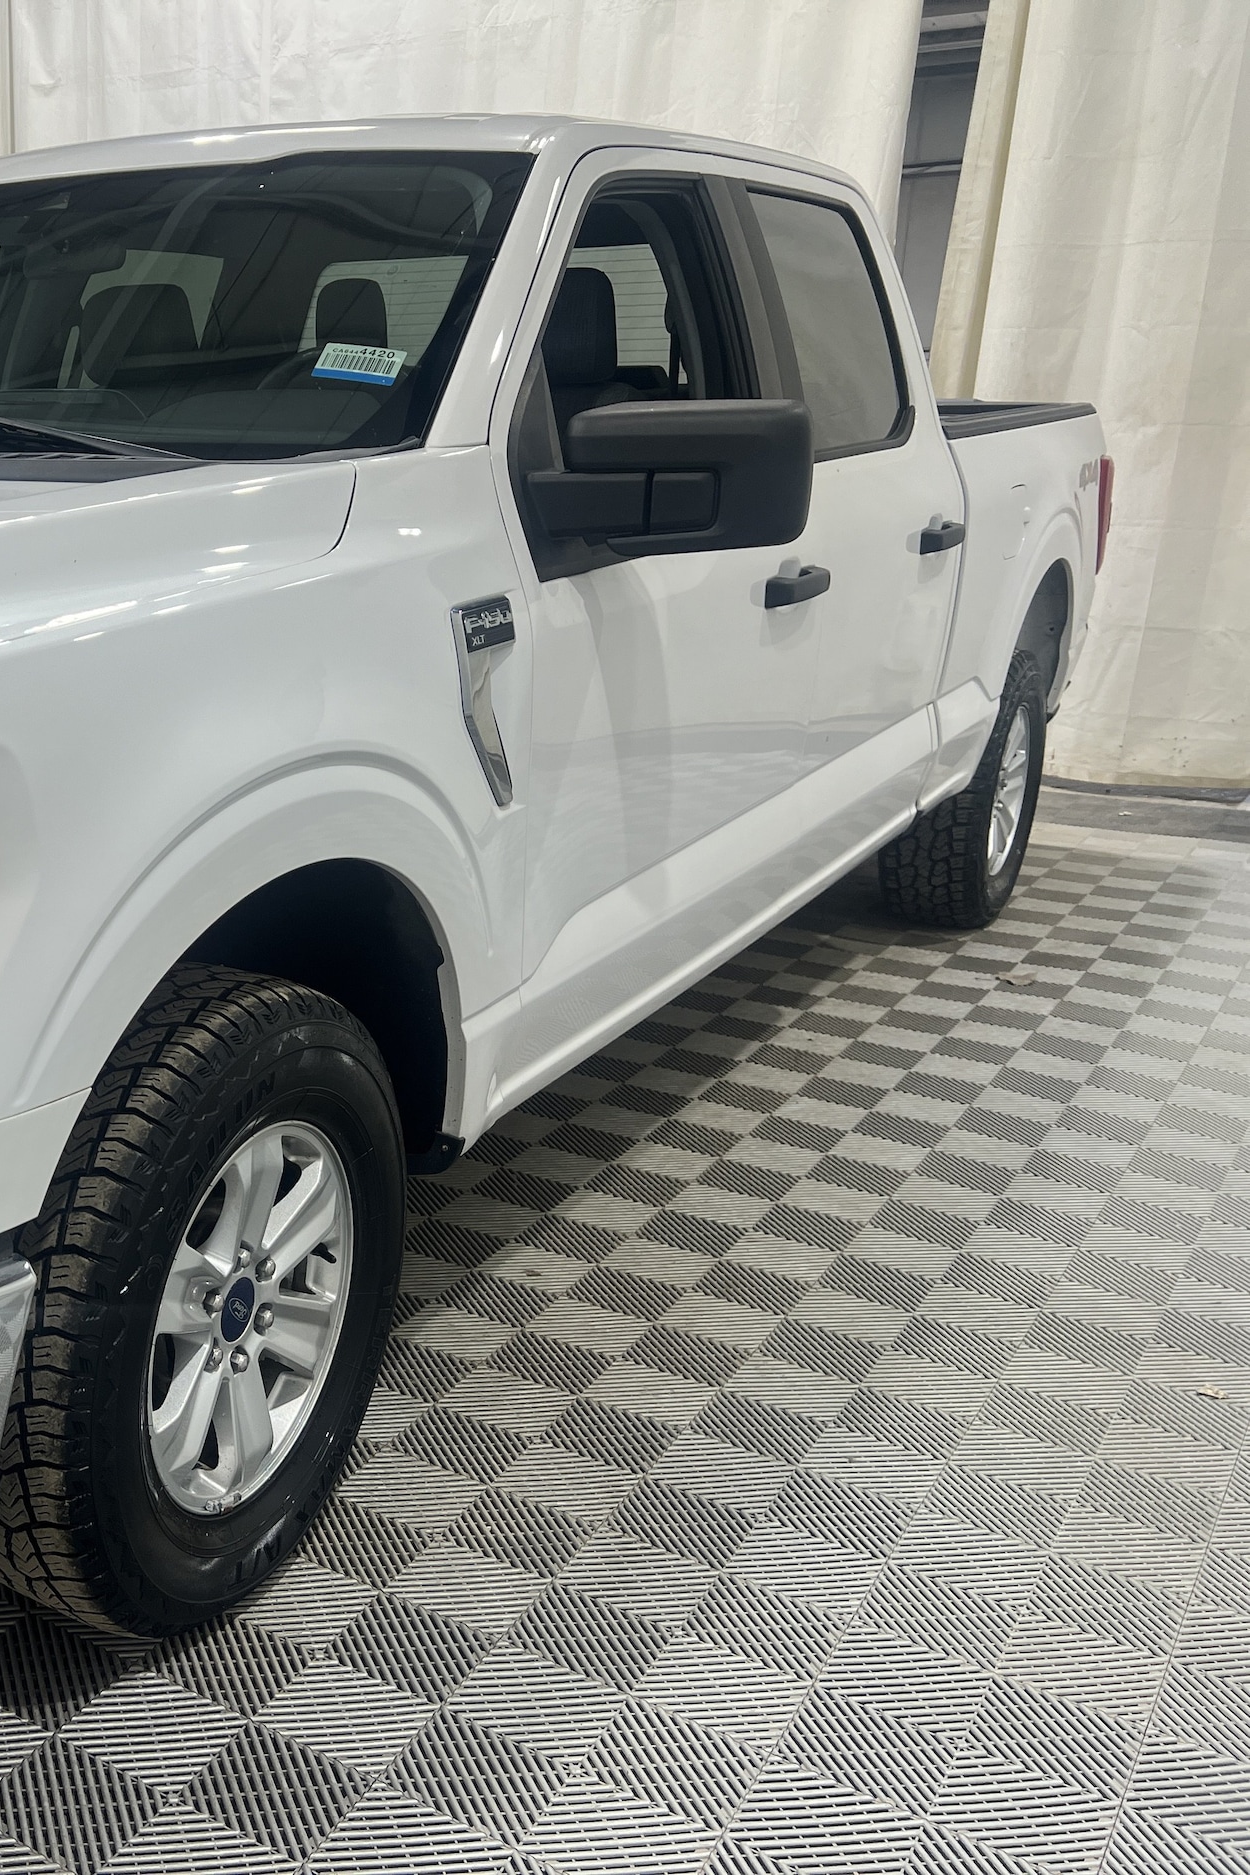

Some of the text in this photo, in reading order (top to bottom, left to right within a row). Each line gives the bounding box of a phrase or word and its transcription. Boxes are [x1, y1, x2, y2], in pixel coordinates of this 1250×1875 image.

[464, 608, 513, 634] F-150
[471, 634, 486, 647] XLT
[166, 1071, 276, 1242] SAILUN
[232, 1300, 248, 1320] Ford
